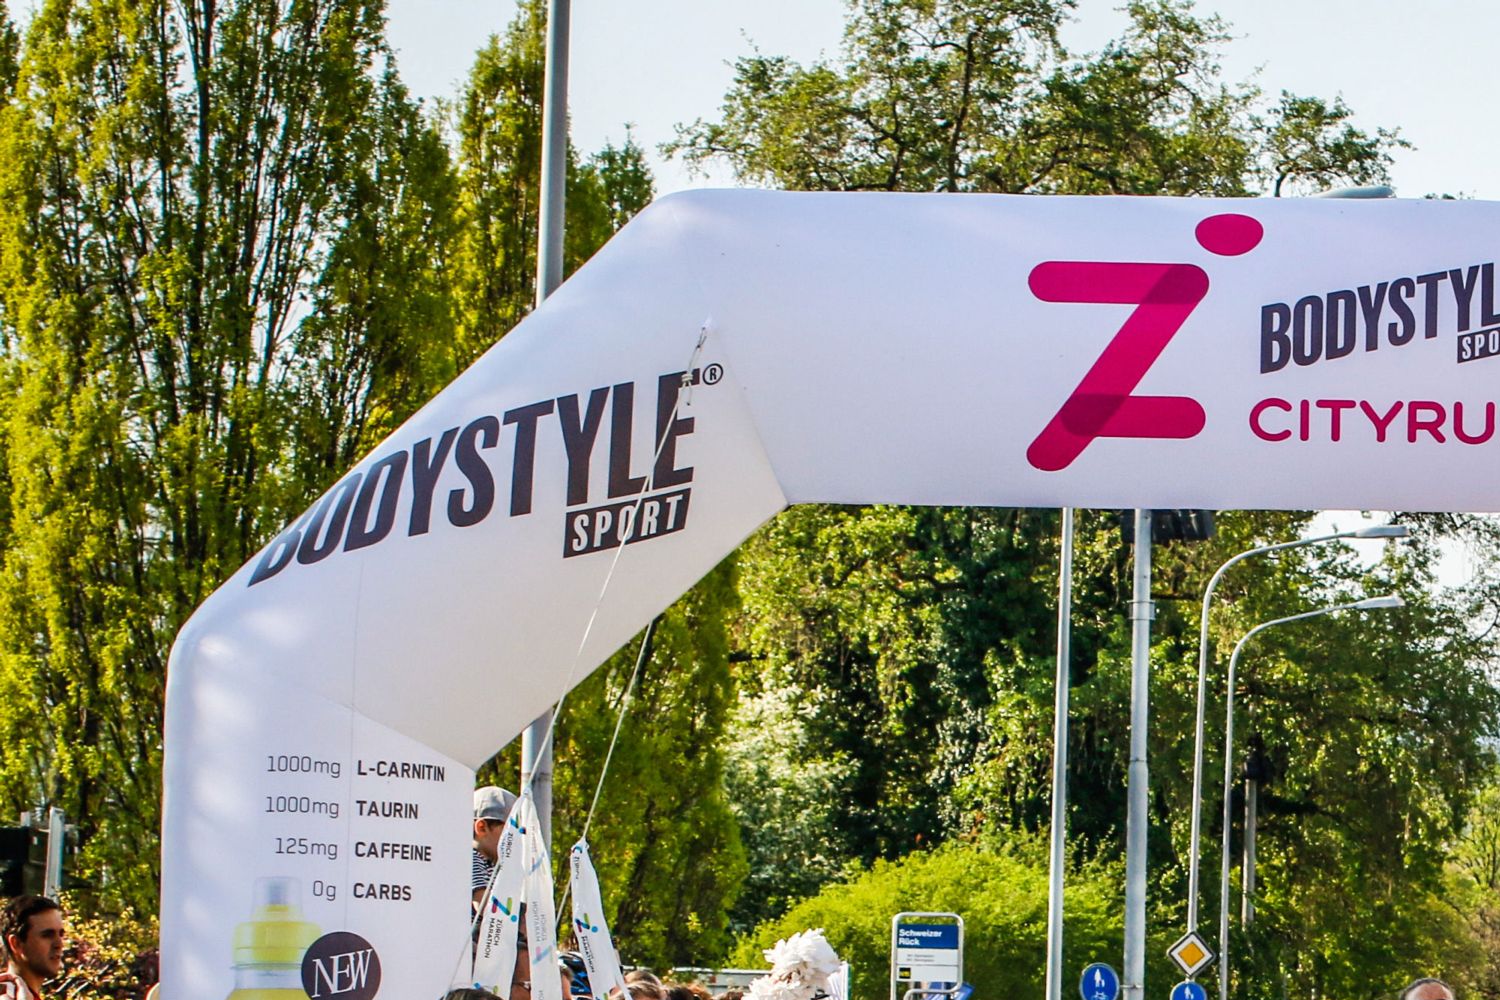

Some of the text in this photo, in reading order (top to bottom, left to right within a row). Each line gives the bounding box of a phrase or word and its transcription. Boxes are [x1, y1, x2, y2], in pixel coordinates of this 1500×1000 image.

[572, 491, 684, 554] SPORT
[267, 755, 446, 783] 1000mg L-CARNITIN
[265, 795, 419, 819] 1000mg TAURIN
[275, 837, 432, 862] 125mg CAFFEINE
[312, 880, 412, 902] 0g CARBS
[484, 917, 496, 959] MARATHON
[898, 928, 943, 938] Schweizer
[898, 937, 921, 946] Rück
[310, 948, 373, 999] NEW
